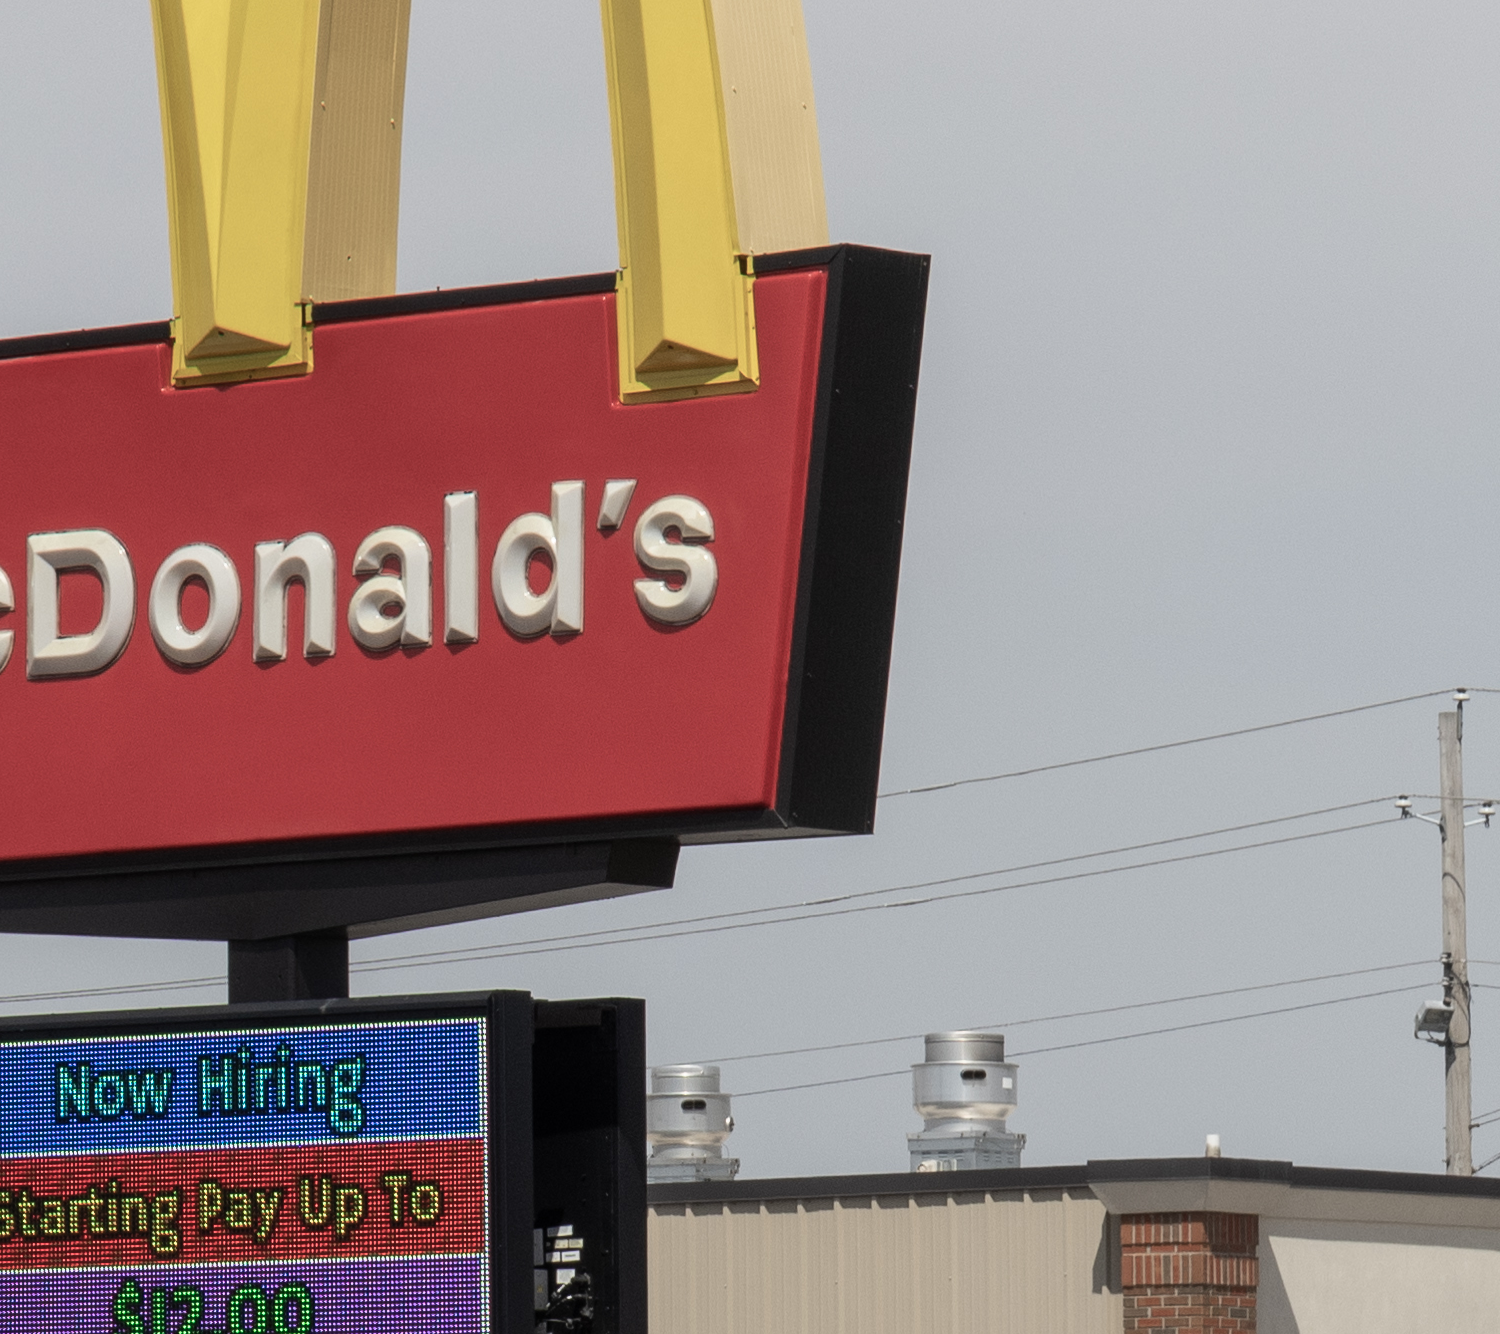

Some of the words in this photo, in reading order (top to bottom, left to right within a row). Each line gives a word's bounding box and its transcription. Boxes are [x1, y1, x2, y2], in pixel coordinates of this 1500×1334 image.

[56, 1064, 172, 1119] Now
[201, 1044, 365, 1133] Hiring
[200, 1181, 282, 1243] Pay
[301, 1176, 364, 1237] Up
[384, 1174, 440, 1223] To
